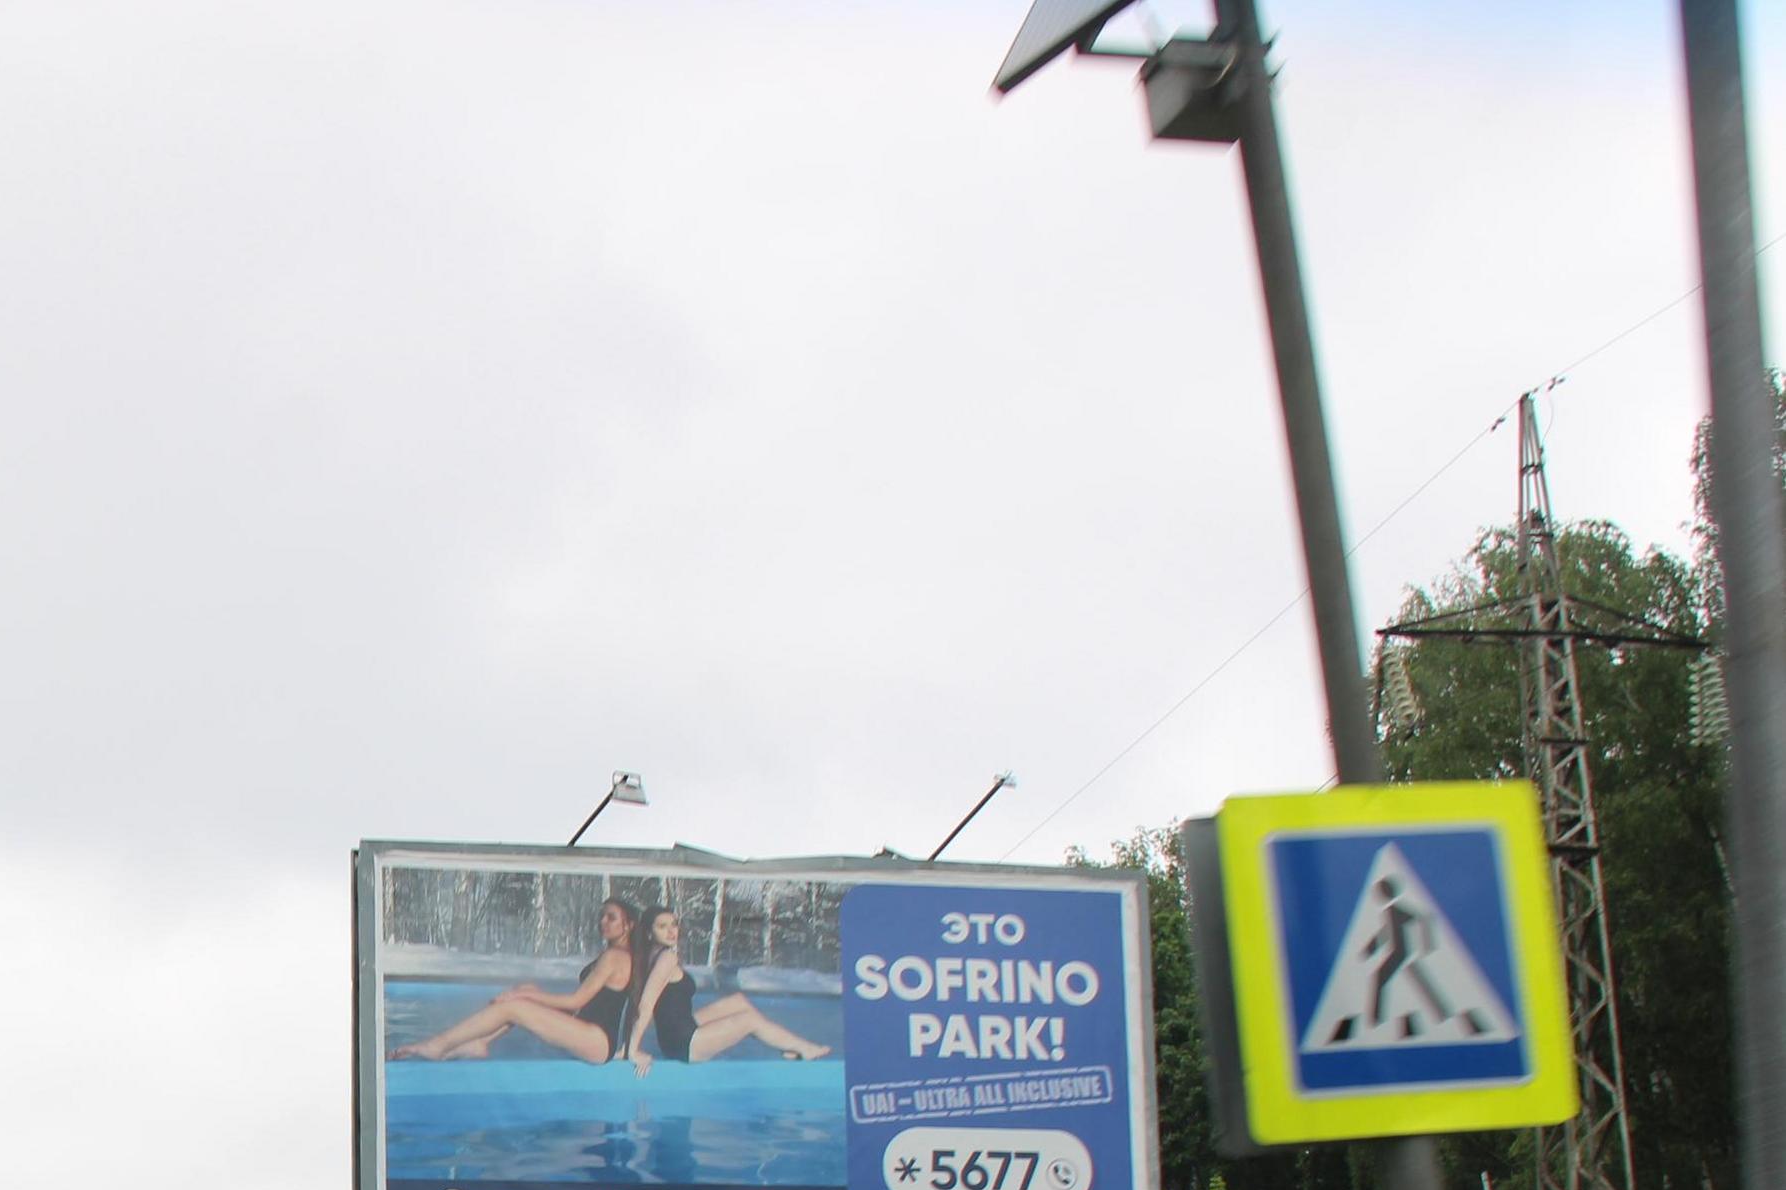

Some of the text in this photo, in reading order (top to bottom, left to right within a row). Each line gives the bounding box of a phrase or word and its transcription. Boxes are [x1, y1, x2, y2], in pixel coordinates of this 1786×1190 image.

[941, 912, 1025, 946] ЭТО
[855, 954, 1100, 1007] SOFRINO
[909, 1013, 1065, 1062] PARK!
[914, 1086, 971, 1111] ULTRA
[974, 1084, 1006, 1106] ALL
[1008, 1074, 1103, 1103] INCLUSIVE
